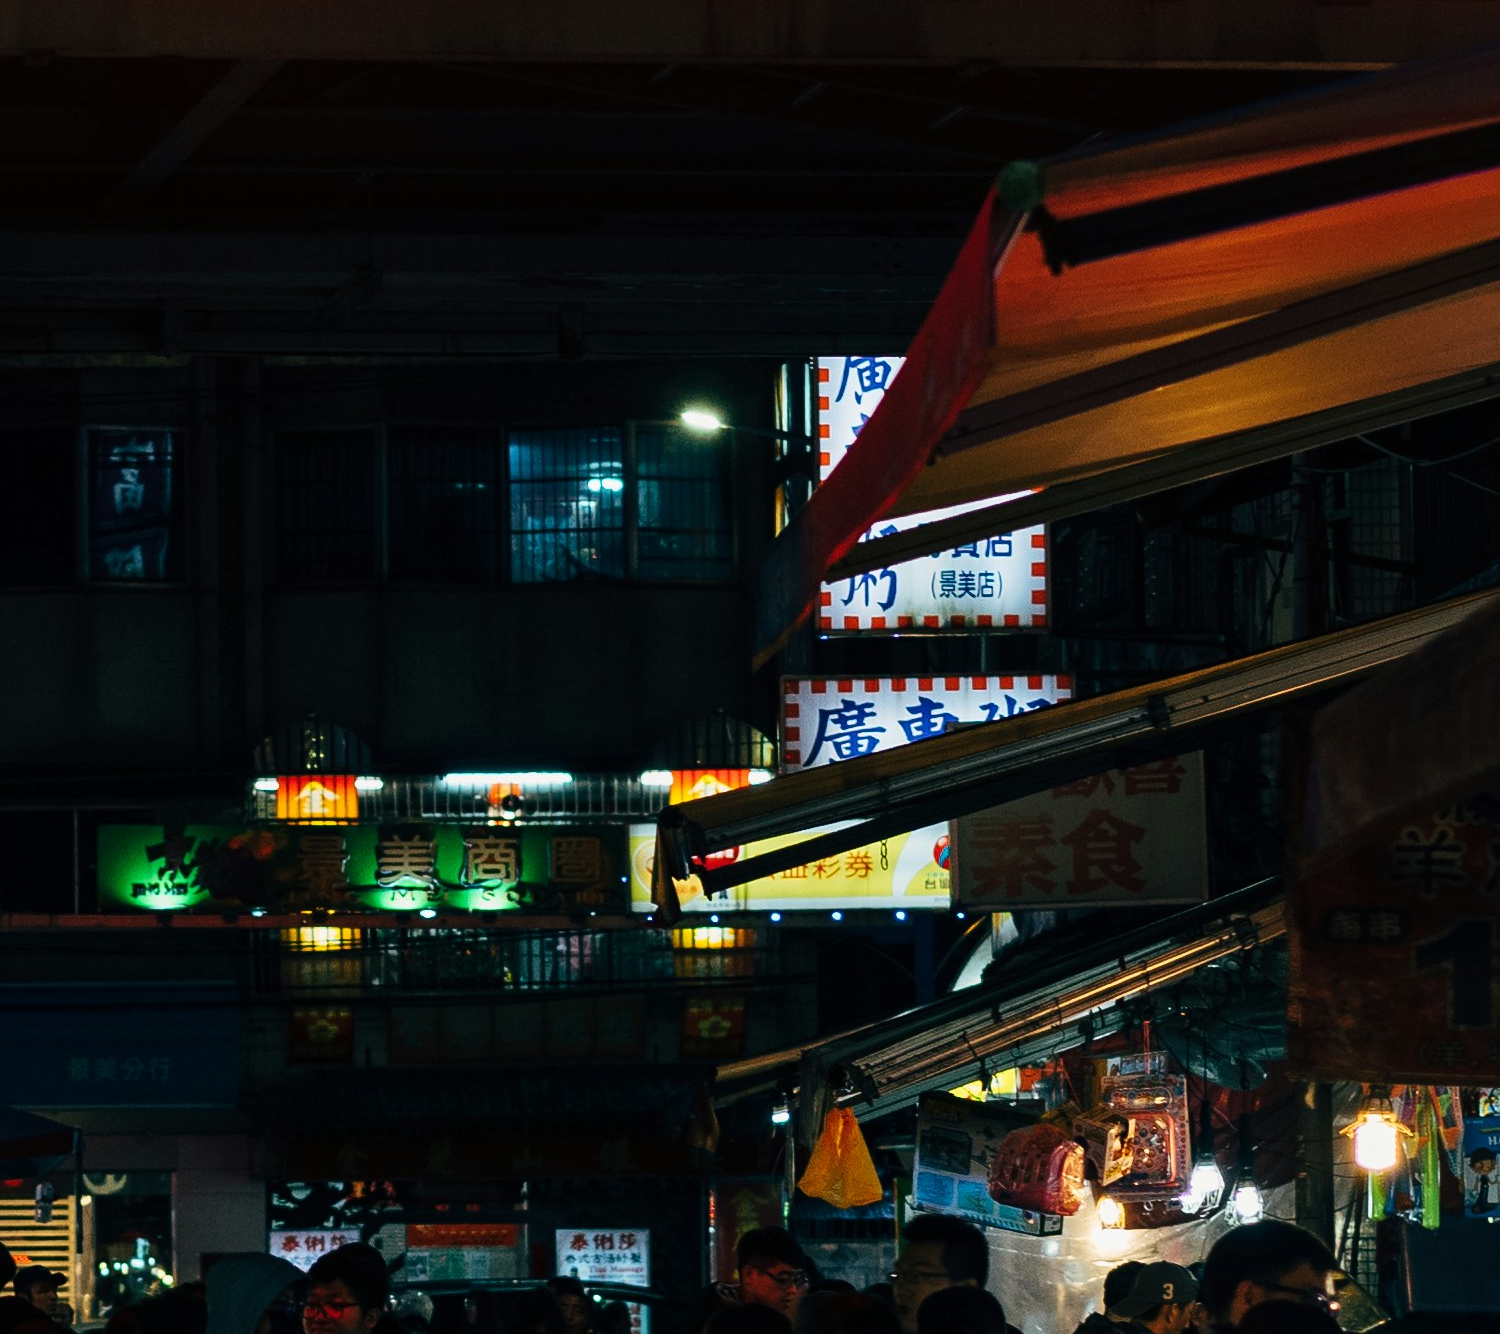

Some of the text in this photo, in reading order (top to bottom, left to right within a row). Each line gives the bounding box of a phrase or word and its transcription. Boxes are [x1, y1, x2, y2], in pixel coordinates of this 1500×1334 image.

[930, 570, 1003, 599] (景美店)
[300, 833, 608, 886] 景美商圈
[968, 808, 1148, 900] 素食
[1161, 1283, 1174, 1300] 3
